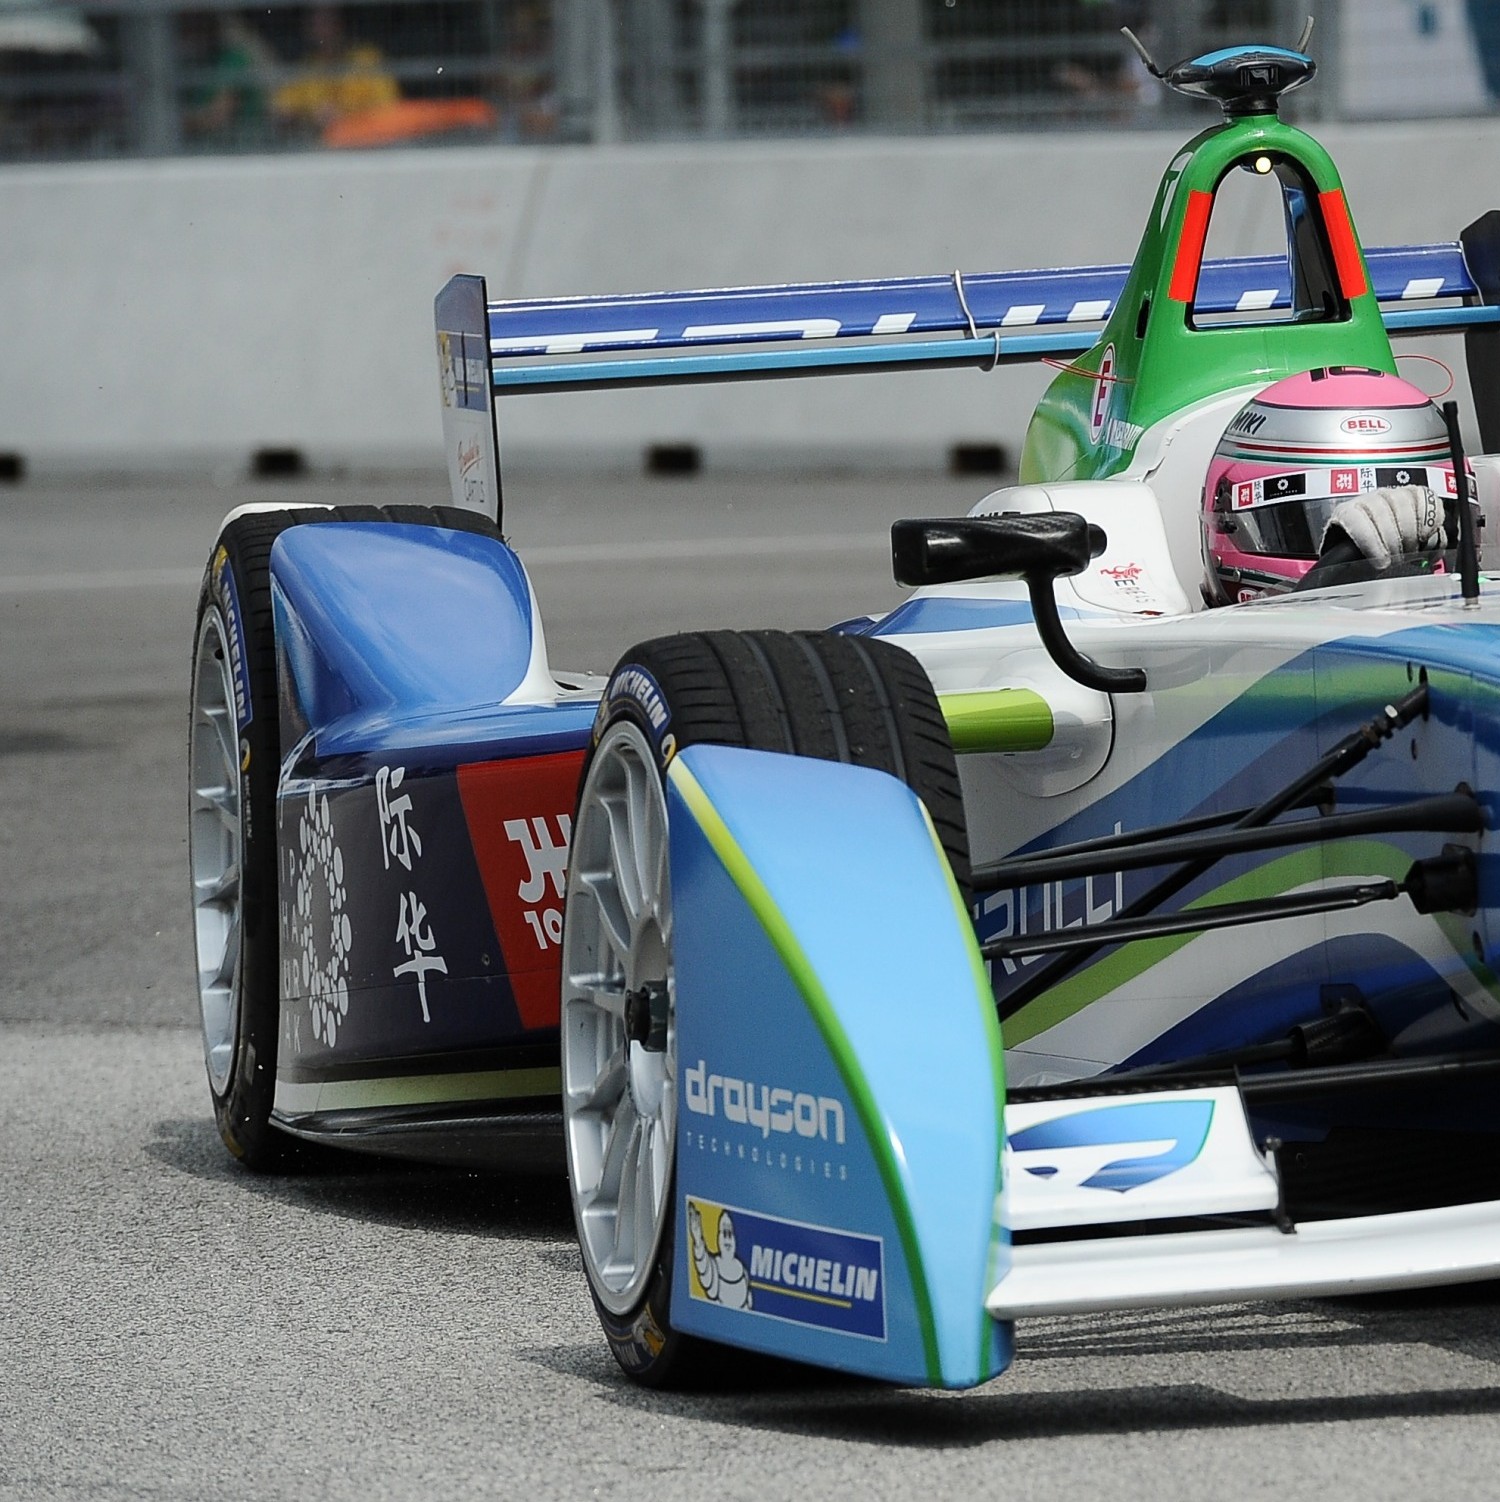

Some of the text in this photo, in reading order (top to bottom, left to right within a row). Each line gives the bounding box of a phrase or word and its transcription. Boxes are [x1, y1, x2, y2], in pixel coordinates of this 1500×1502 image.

[1230, 411, 1267, 435] MIKI
[1347, 419, 1386, 429] BELL
[609, 670, 667, 729] MICHELIN
[376, 766, 448, 1023] 际华
[685, 1059, 846, 1144] drayson
[687, 1131, 848, 1181] TECHNOLOGIES
[750, 1244, 878, 1301] MICHELIN
